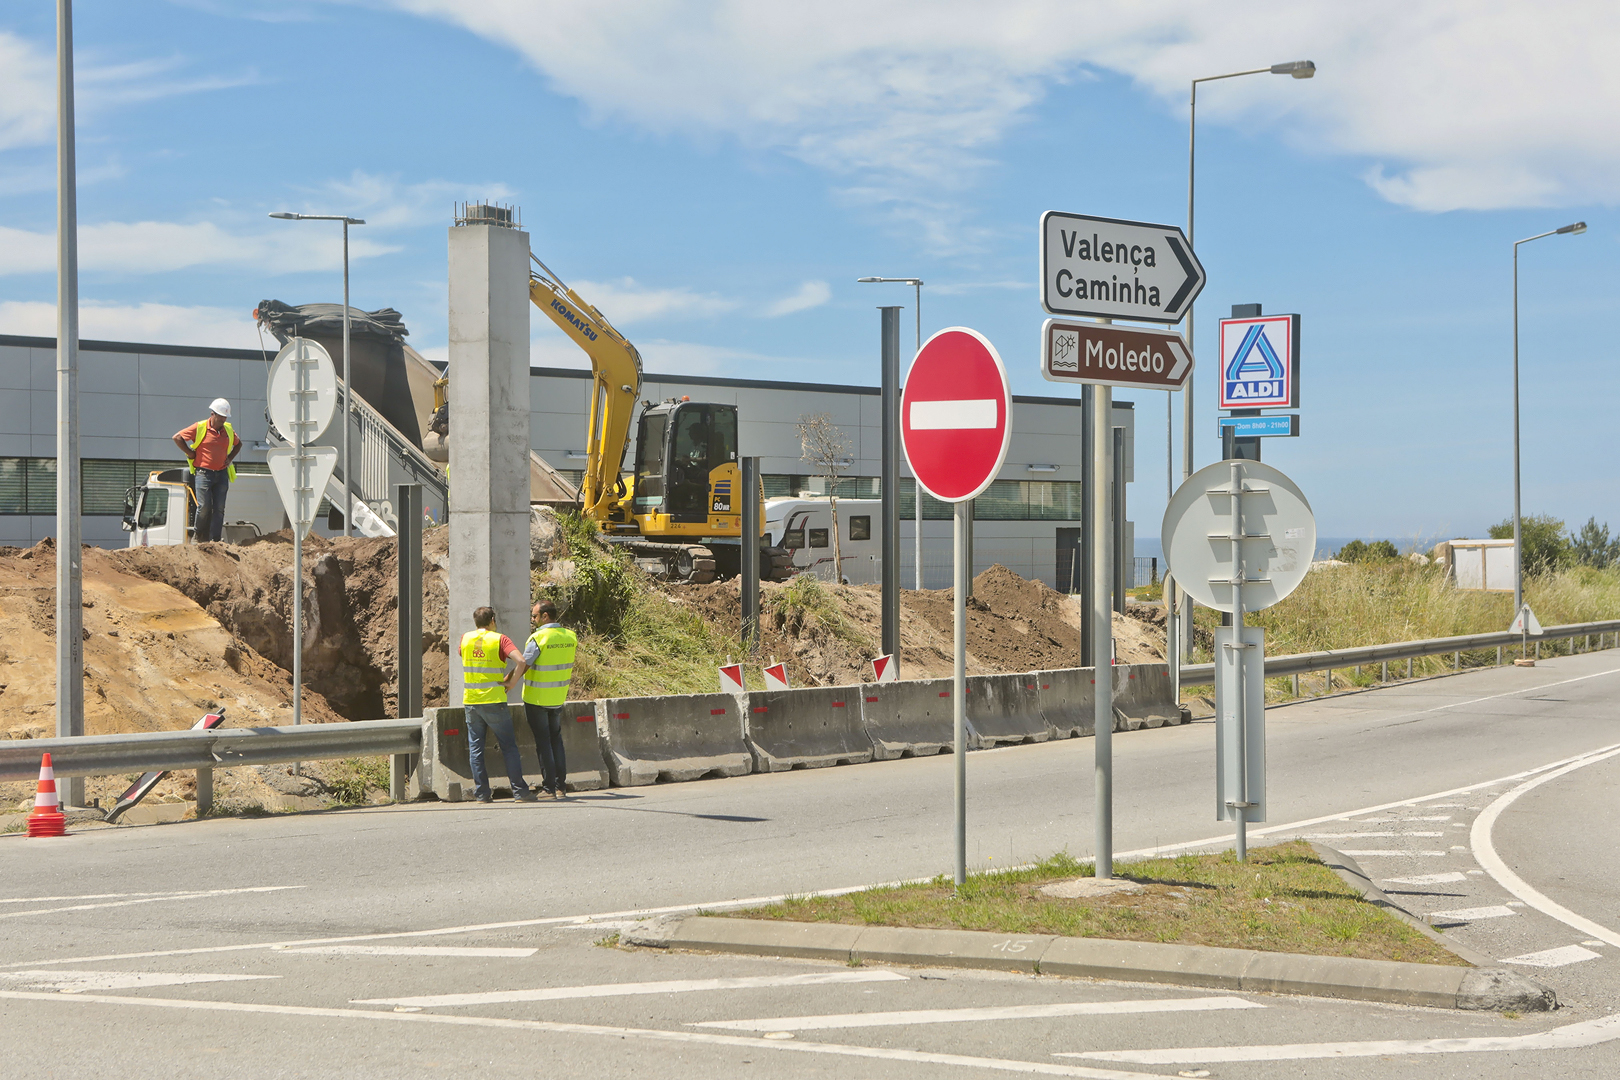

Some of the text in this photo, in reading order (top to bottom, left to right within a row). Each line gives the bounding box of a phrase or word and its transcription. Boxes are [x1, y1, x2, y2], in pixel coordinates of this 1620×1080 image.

[1060, 229, 1156, 274] Valença
[1056, 269, 1160, 307] Caminha
[550, 298, 598, 341] KOMATSU
[1085, 339, 1164, 374] Moledo
[1231, 381, 1279, 398] ALDI
[992, 939, 1034, 953] 15
